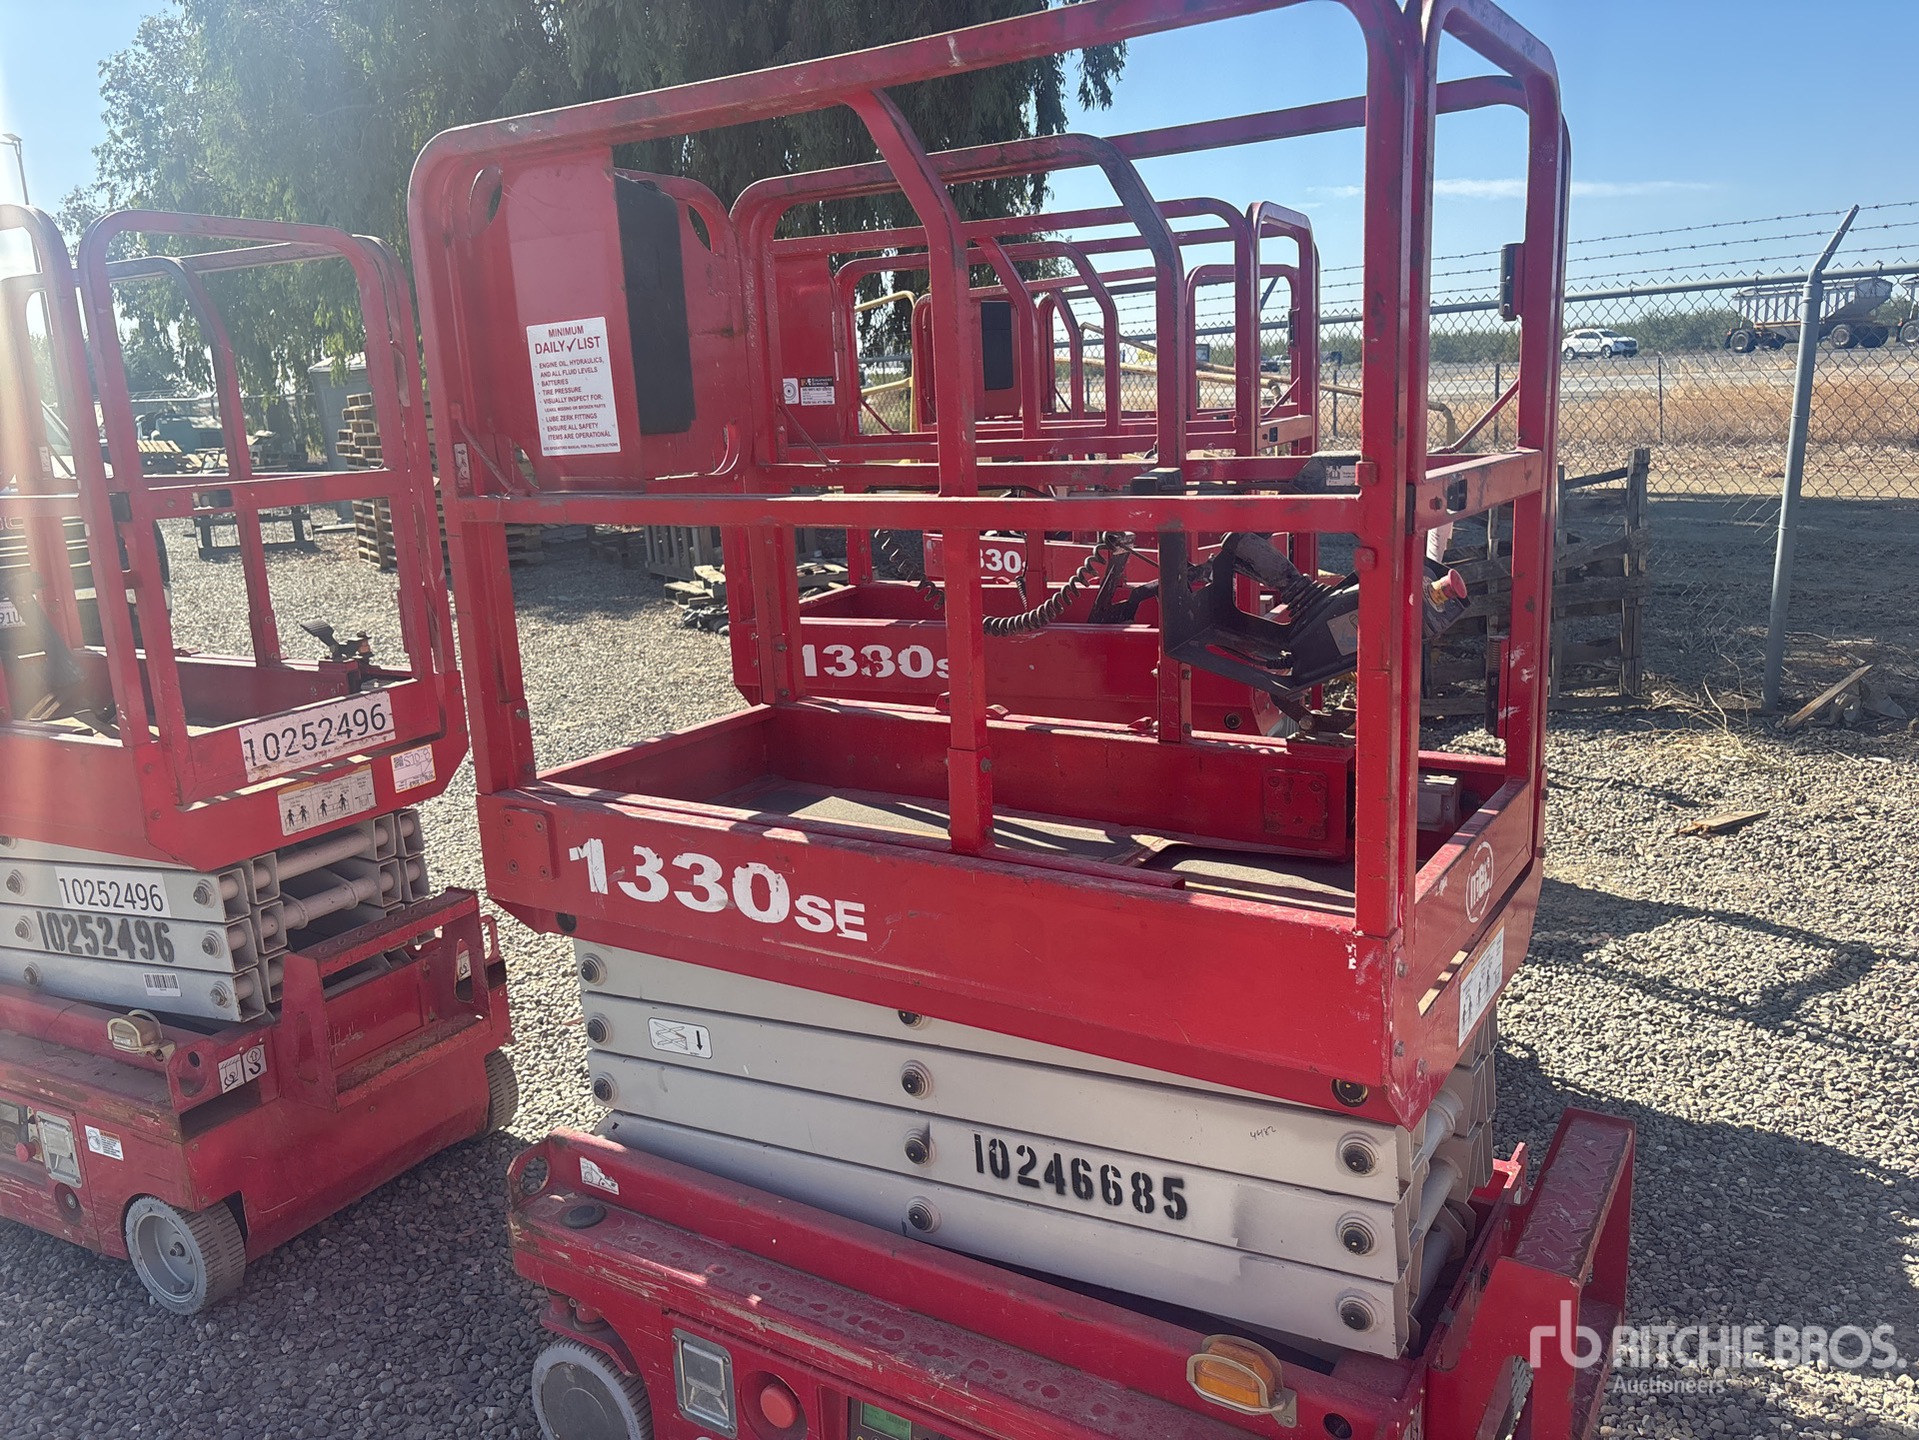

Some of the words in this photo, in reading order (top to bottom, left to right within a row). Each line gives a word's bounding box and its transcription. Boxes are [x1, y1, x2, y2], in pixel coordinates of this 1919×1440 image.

[548, 325, 585, 338] MINIMUM
[534, 340, 565, 355] DAILY
[577, 336, 601, 350] LIST
[539, 360, 558, 369] ENGINE
[540, 370, 551, 378] AND
[552, 369, 561, 377] ALL
[562, 368, 577, 376] FLUID
[577, 366, 598, 374] LEVELS
[541, 378, 569, 387] BATTERIES
[554, 386, 582, 395] PRESSURE
[543, 396, 567, 404] VISUALLY
[568, 395, 589, 403] INSPECT
[545, 415, 559, 423] LUBE
[546, 424, 567, 432] ENSURE
[568, 423, 578, 431] ALL
[578, 422, 599, 430] SAFETY
[547, 433, 563, 441] ITEMS
[575, 430, 611, 439] OPERATIONAL
[244, 703, 386, 767] 10252496
[59, 877, 164, 913] 10252496
[568, 838, 868, 942] 1330SE
[36, 910, 175, 963] 10252496
[973, 1133, 1188, 1221] 10246685
